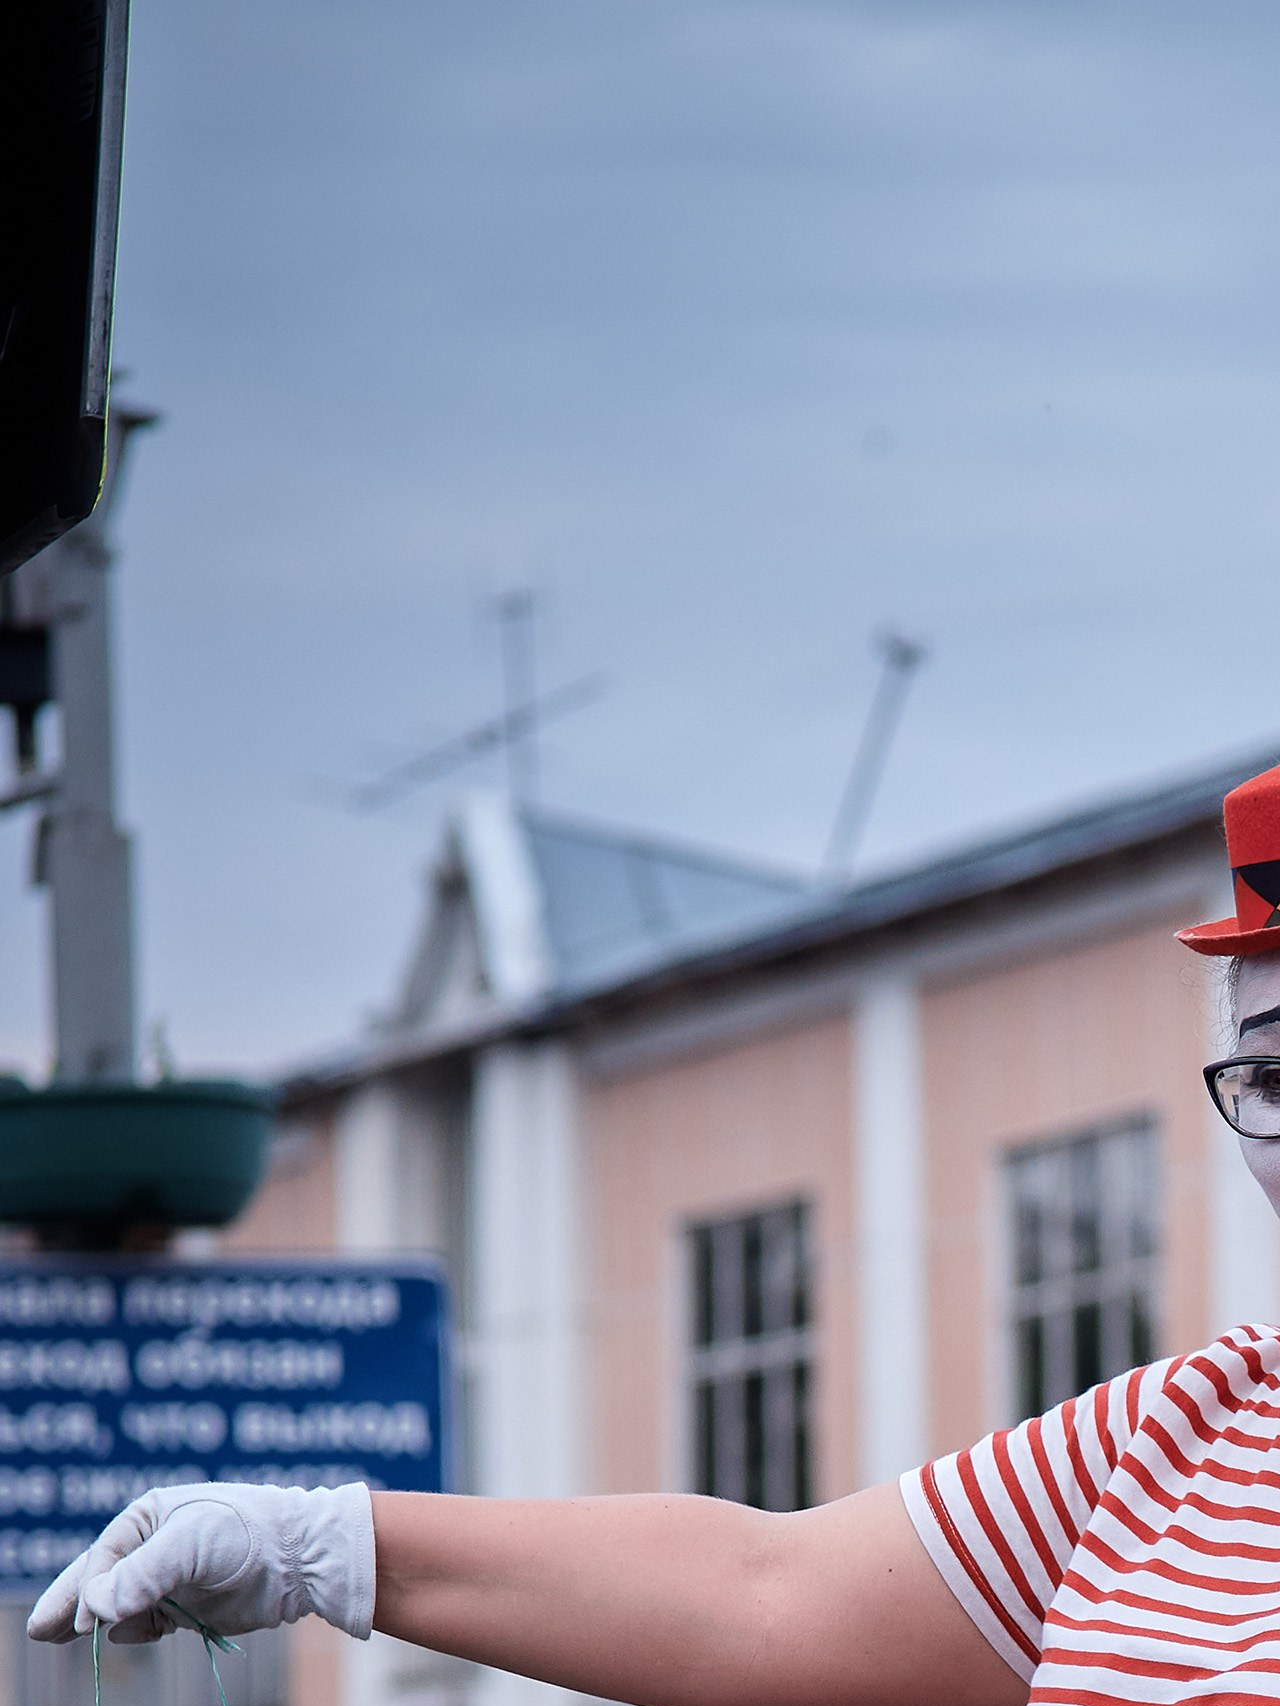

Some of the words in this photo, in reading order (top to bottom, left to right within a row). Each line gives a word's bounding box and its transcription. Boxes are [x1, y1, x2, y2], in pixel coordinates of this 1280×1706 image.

[124, 1278, 399, 1338] перехода
[136, 1328, 342, 1388] обязан
[121, 1403, 227, 1451] что
[233, 1403, 429, 1457] выход
